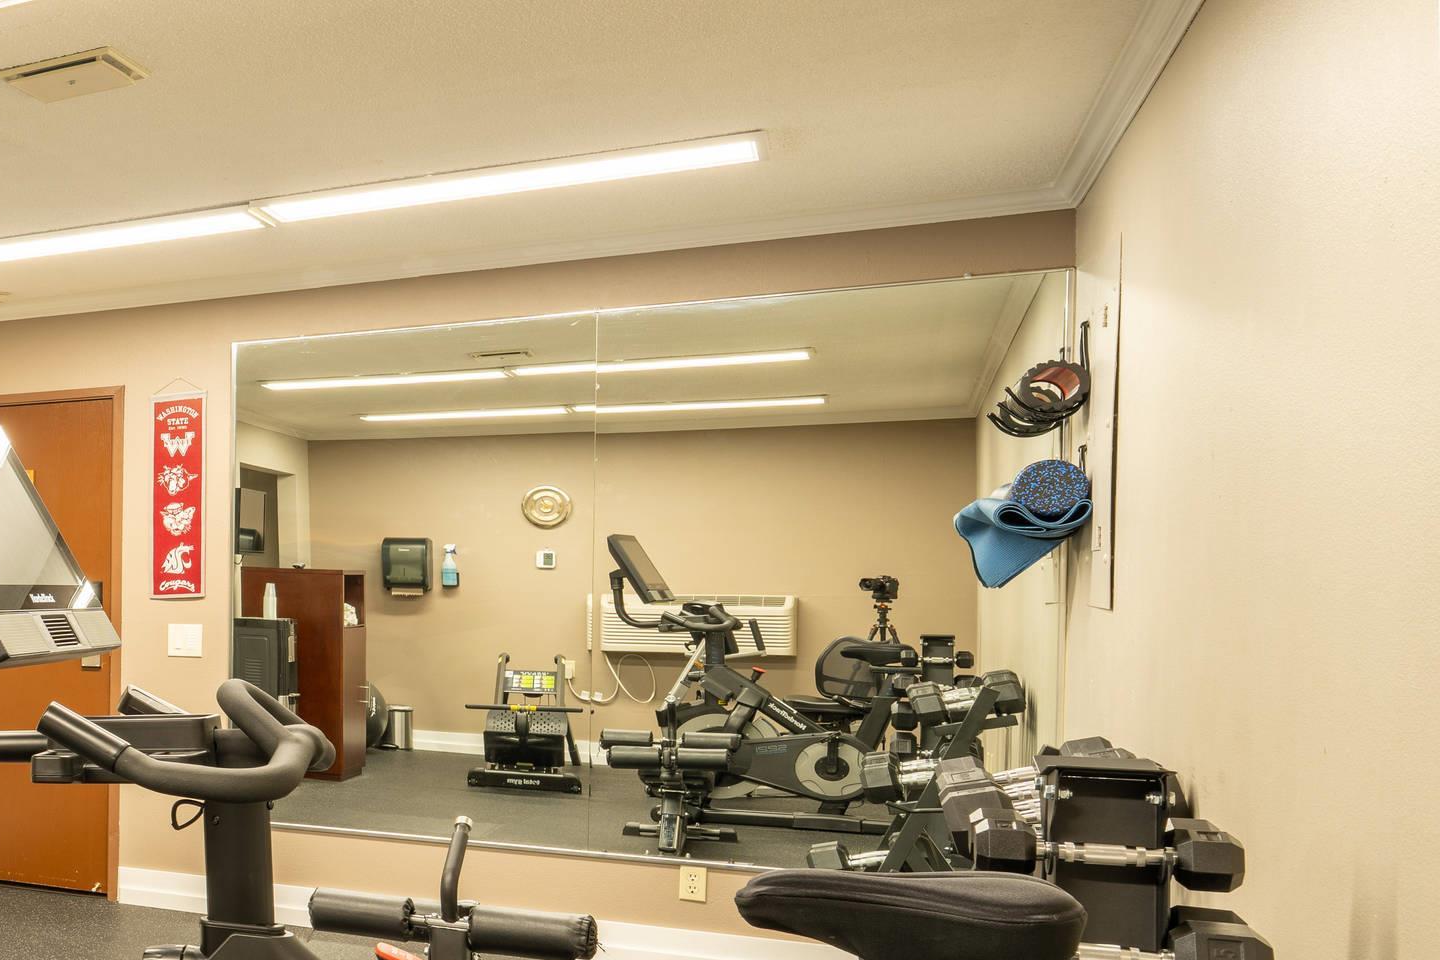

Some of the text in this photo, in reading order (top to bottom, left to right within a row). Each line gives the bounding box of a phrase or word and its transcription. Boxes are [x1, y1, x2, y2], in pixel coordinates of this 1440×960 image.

[156, 405, 199, 421] WASHINGTON
[167, 417, 188, 425] STATE
[159, 579, 195, 592] Cougars
